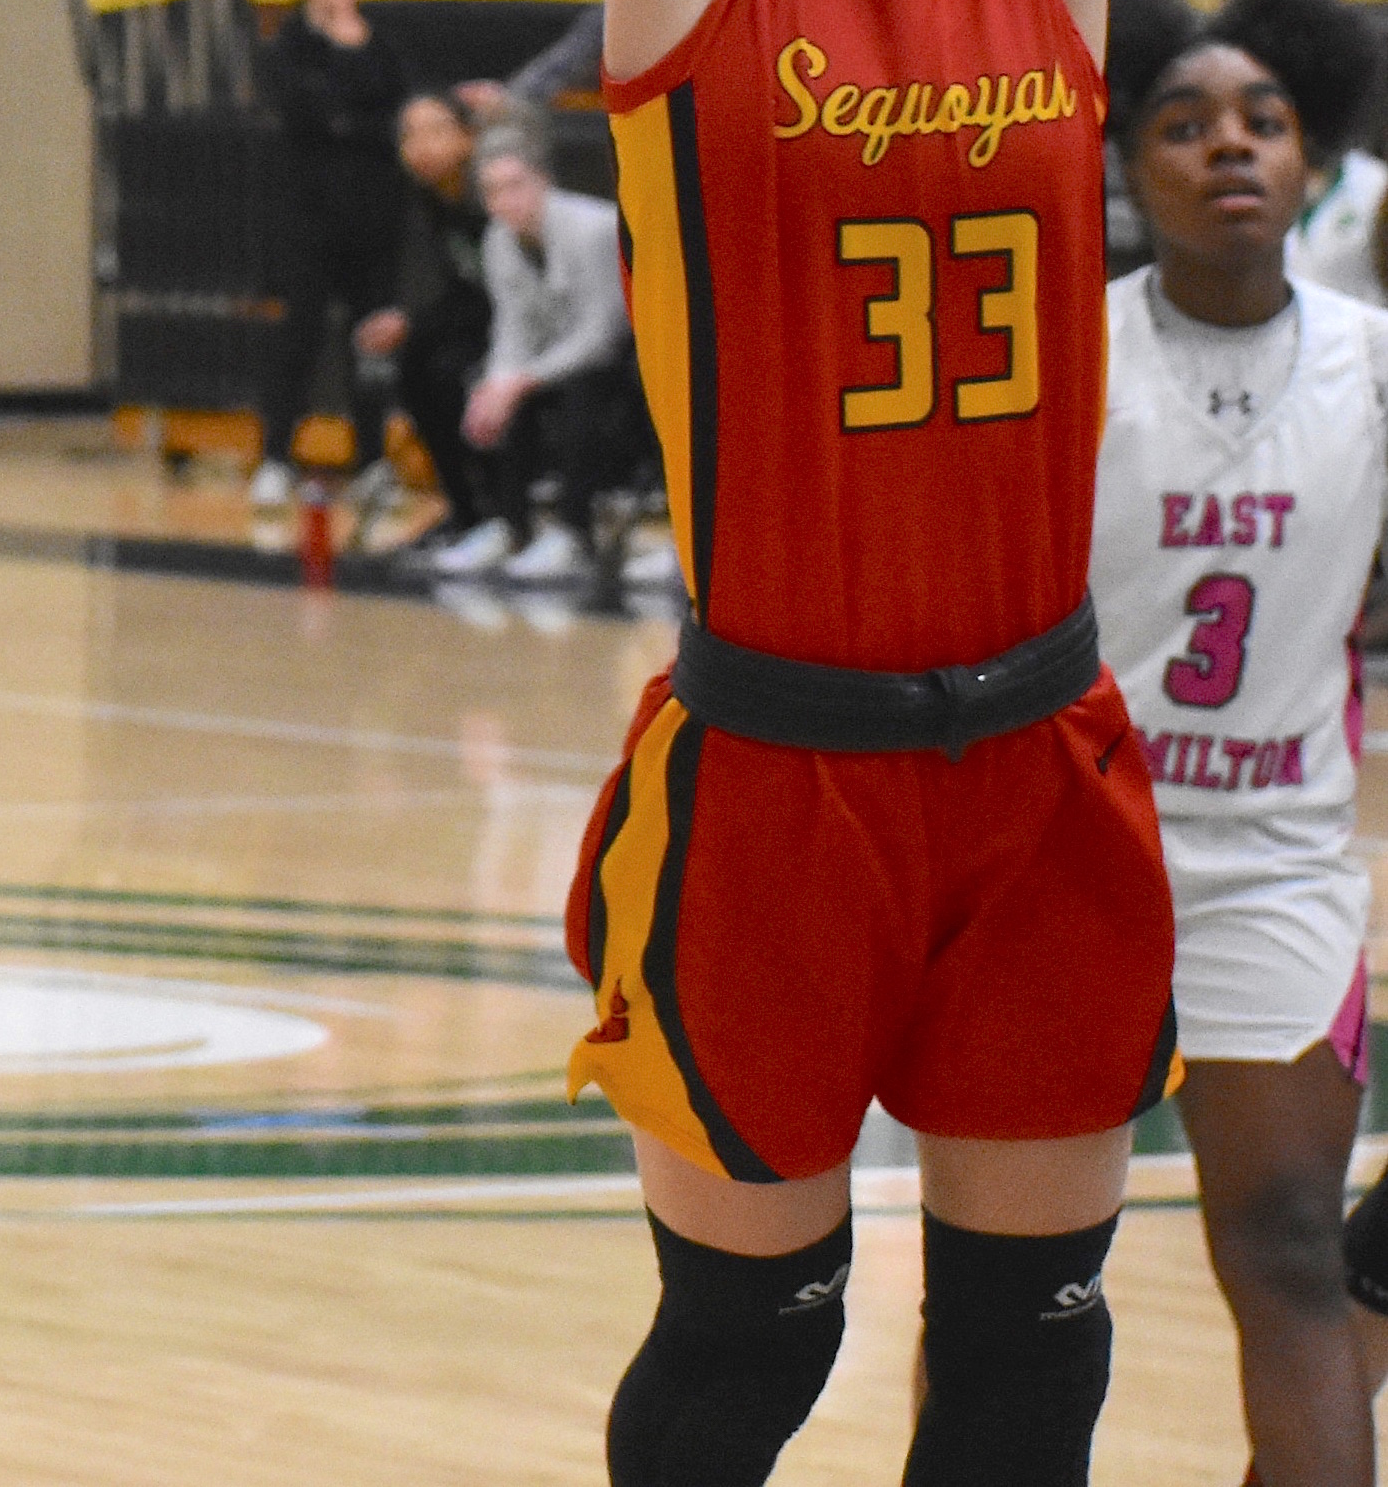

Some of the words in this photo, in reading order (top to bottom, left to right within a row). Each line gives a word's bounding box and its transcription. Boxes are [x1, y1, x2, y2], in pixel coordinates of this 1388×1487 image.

[836, 207, 1040, 435] 33
[1158, 491, 1297, 550] EAST
[1162, 572, 1257, 709] 3
